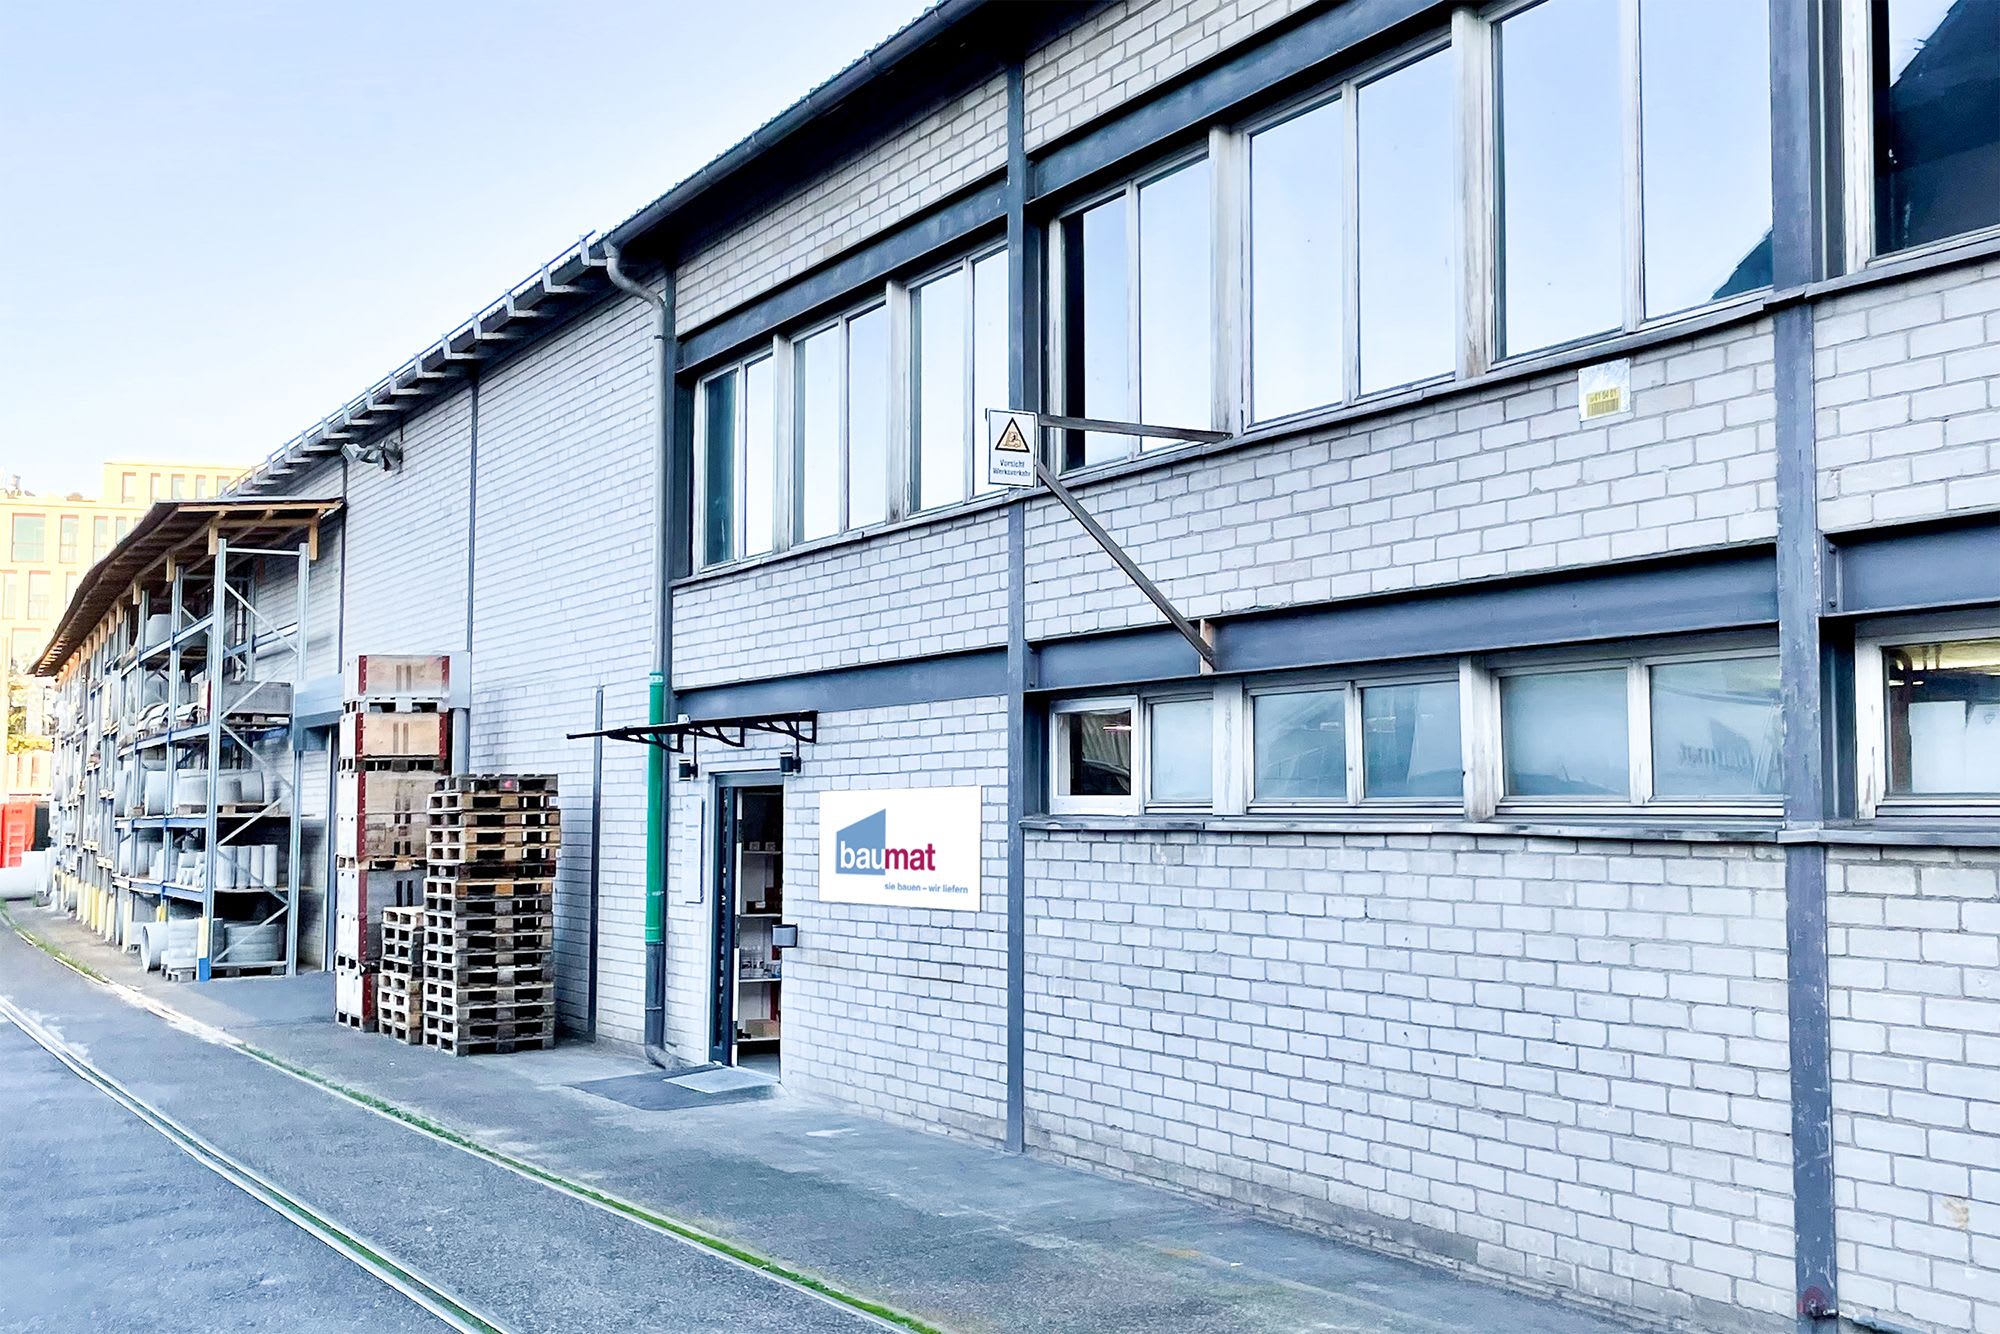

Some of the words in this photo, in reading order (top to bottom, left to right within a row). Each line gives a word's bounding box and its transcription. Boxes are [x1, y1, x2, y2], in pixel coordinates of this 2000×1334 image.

[1000, 459, 1025, 468] Vorsicht
[840, 840, 936, 871] baumat
[884, 882, 896, 890] sie
[897, 882, 921, 891] bauen
[928, 884, 941, 892] wir
[942, 884, 969, 894] liefern
